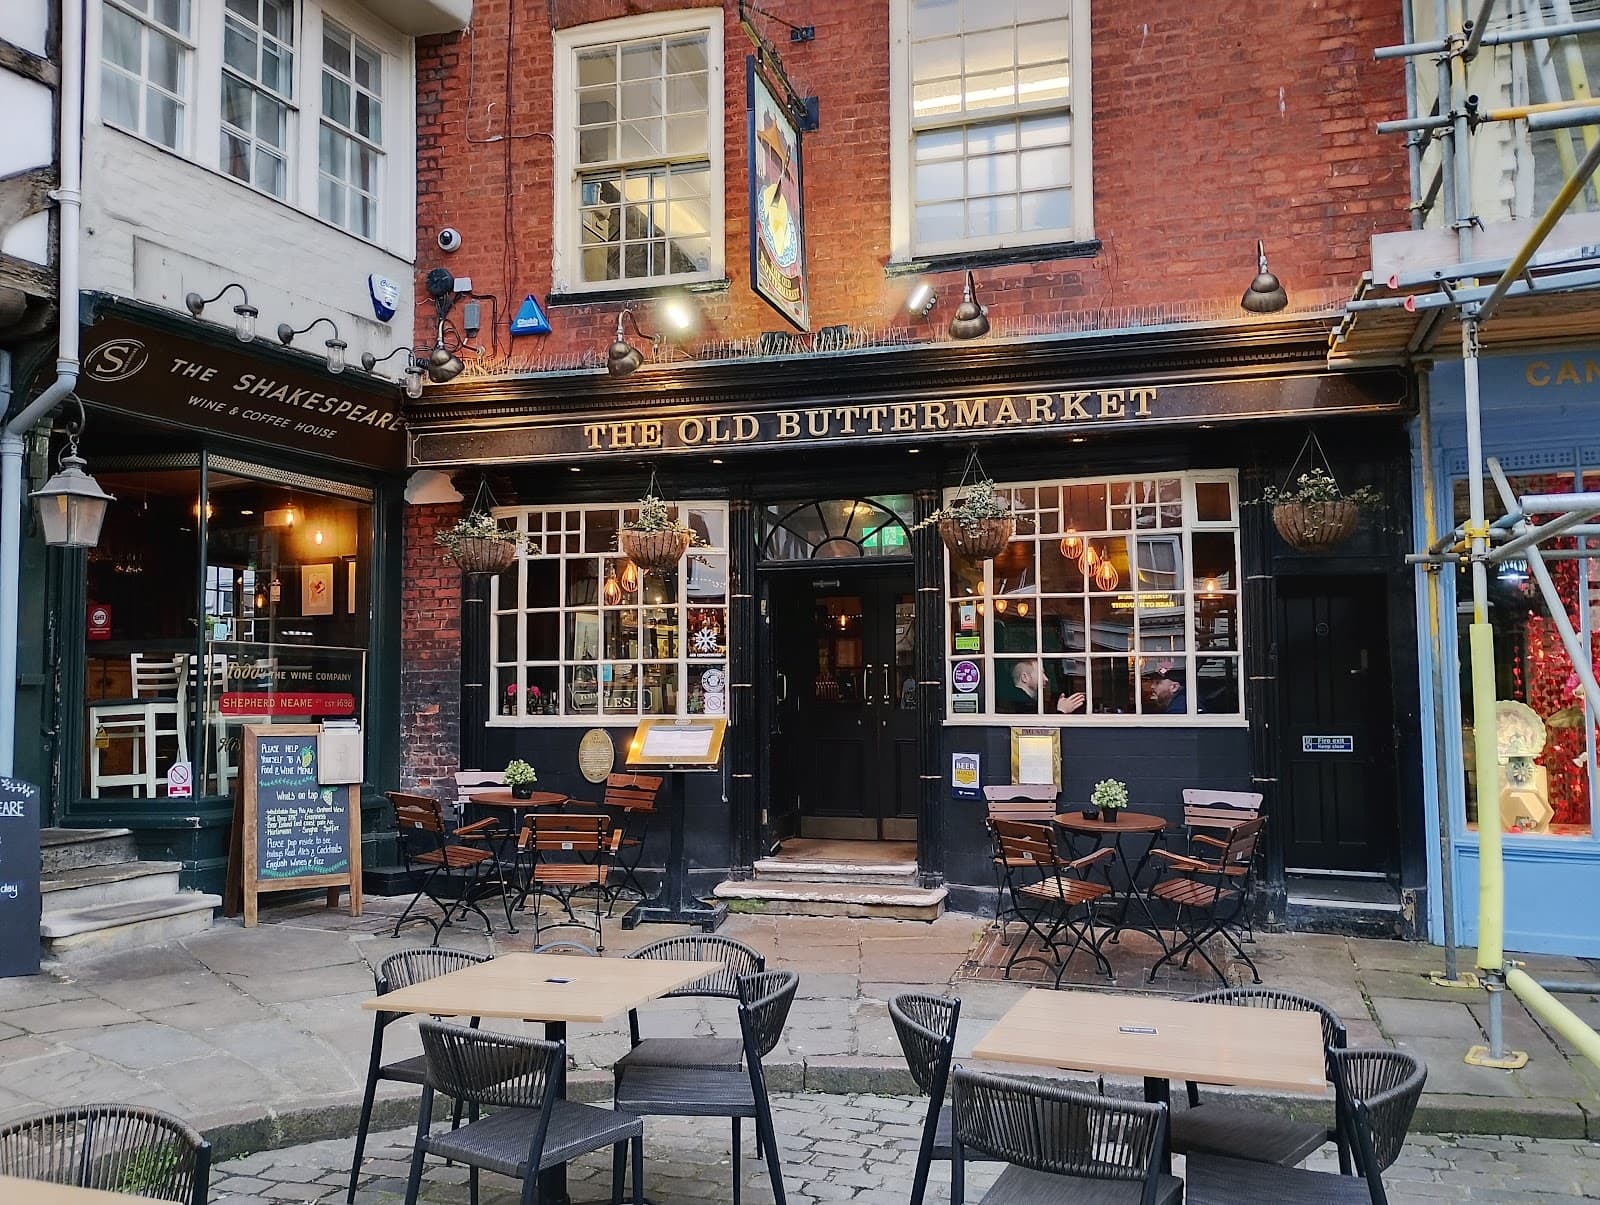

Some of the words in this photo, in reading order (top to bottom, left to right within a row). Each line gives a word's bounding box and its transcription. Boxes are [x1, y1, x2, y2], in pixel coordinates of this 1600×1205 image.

[170, 359, 218, 382] THE
[233, 374, 404, 432] SHAKESPEARE
[188, 396, 227, 413] WINE
[229, 407, 239, 416] &
[242, 410, 291, 429] COFFEE
[294, 422, 339, 440] HOUSE
[584, 421, 663, 450] THE
[678, 415, 760, 446] OLD
[776, 388, 1157, 438] BUTTERMARKET
[269, 671, 286, 681] THE
[291, 671, 314, 681] WINE
[316, 672, 352, 682] COMPANY
[223, 698, 276, 708] SHEPHERD
[280, 698, 313, 708] NEAME
[285, 745, 299, 753] HELP
[296, 756, 302, 764] A
[956, 762, 976, 770] BEER
[298, 792, 306, 800] on
[308, 789, 319, 802] tap
[287, 840, 298, 849] pop
[266, 859, 288, 871] English
